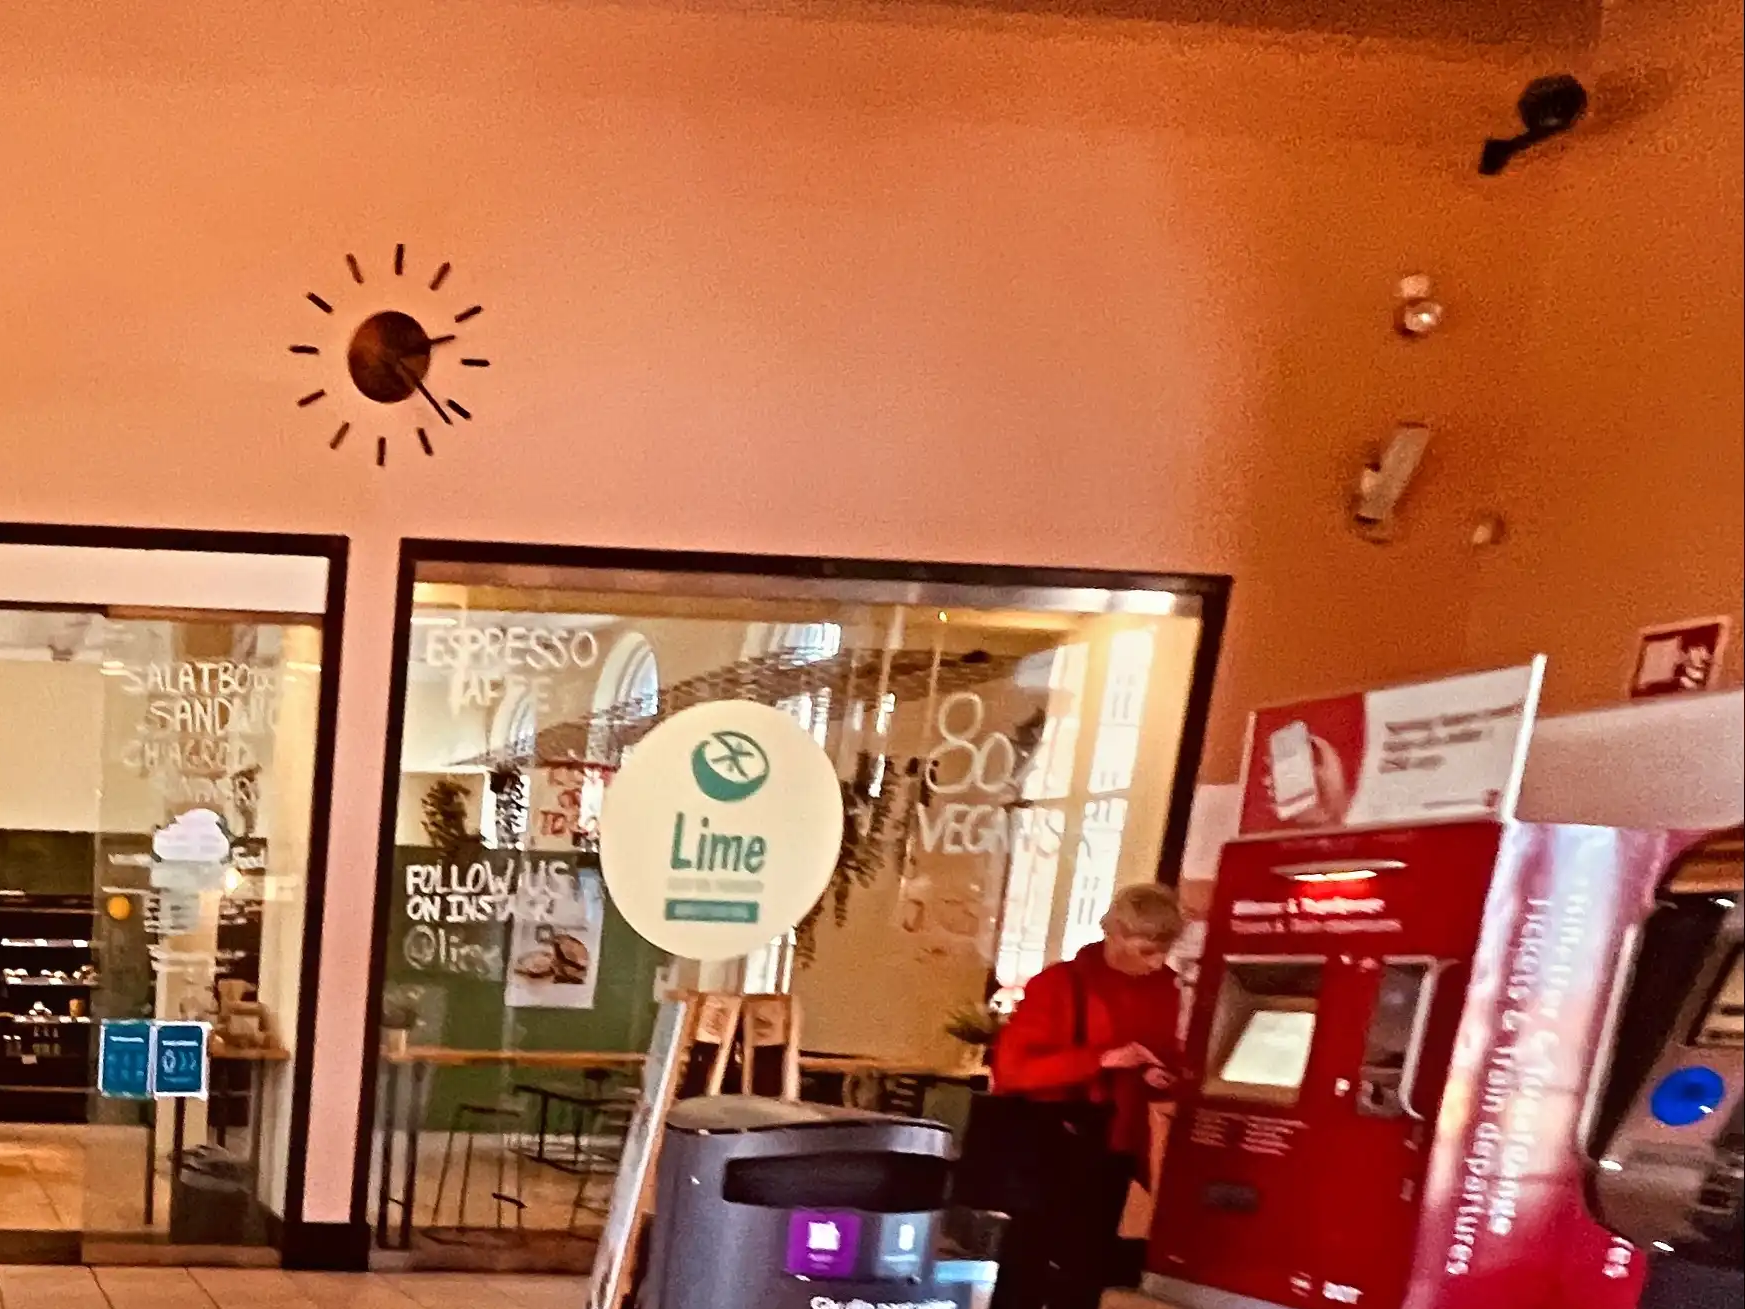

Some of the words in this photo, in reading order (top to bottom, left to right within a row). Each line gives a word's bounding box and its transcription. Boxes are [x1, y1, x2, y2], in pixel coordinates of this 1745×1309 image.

[425, 626, 599, 669] ESPRESSO
[670, 811, 767, 874] Lime
[406, 857, 515, 896] FOLLOW
[406, 894, 443, 922] ON
[1444, 1121, 1504, 1275] departures
